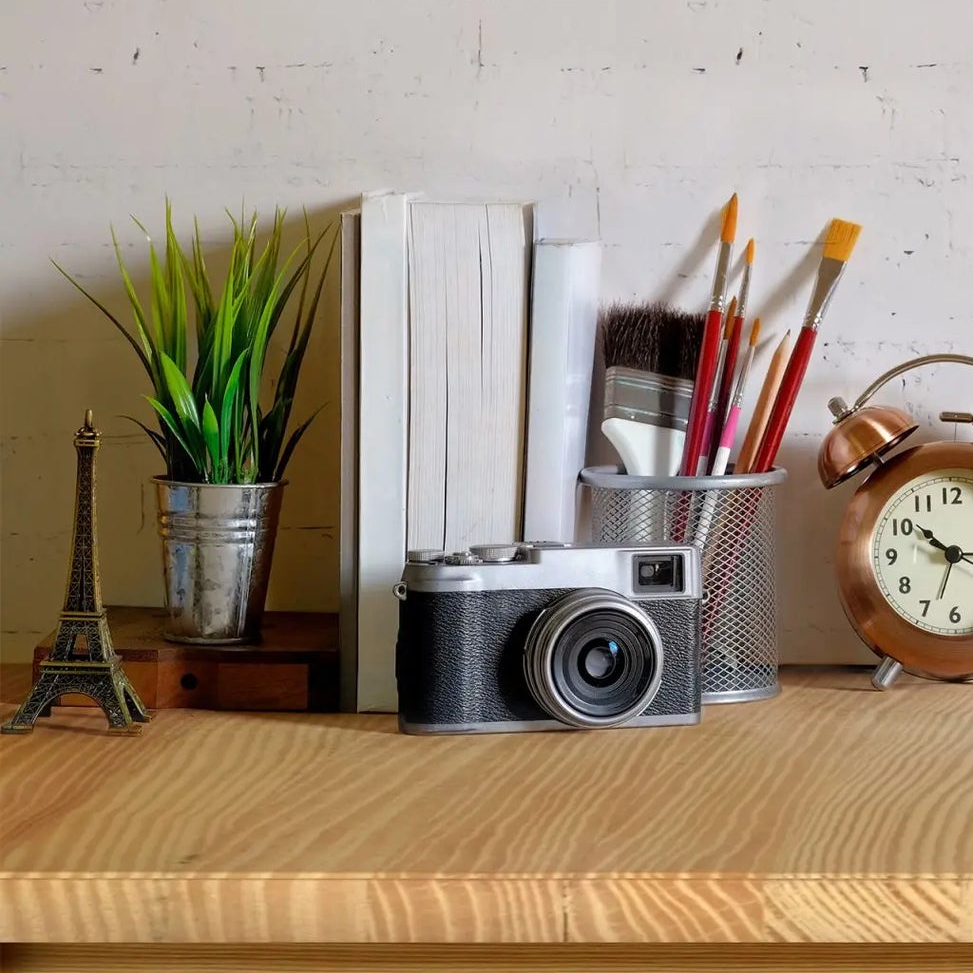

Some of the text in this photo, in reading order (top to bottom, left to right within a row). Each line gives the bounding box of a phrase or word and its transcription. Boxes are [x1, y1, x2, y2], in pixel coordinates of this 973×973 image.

[914, 494, 932, 512] 11
[942, 487, 963, 505] 12
[892, 518, 913, 536] 10
[885, 548, 898, 566] 9
[898, 576, 911, 594] 8
[919, 600, 931, 617] 7
[949, 606, 961, 624] 6
